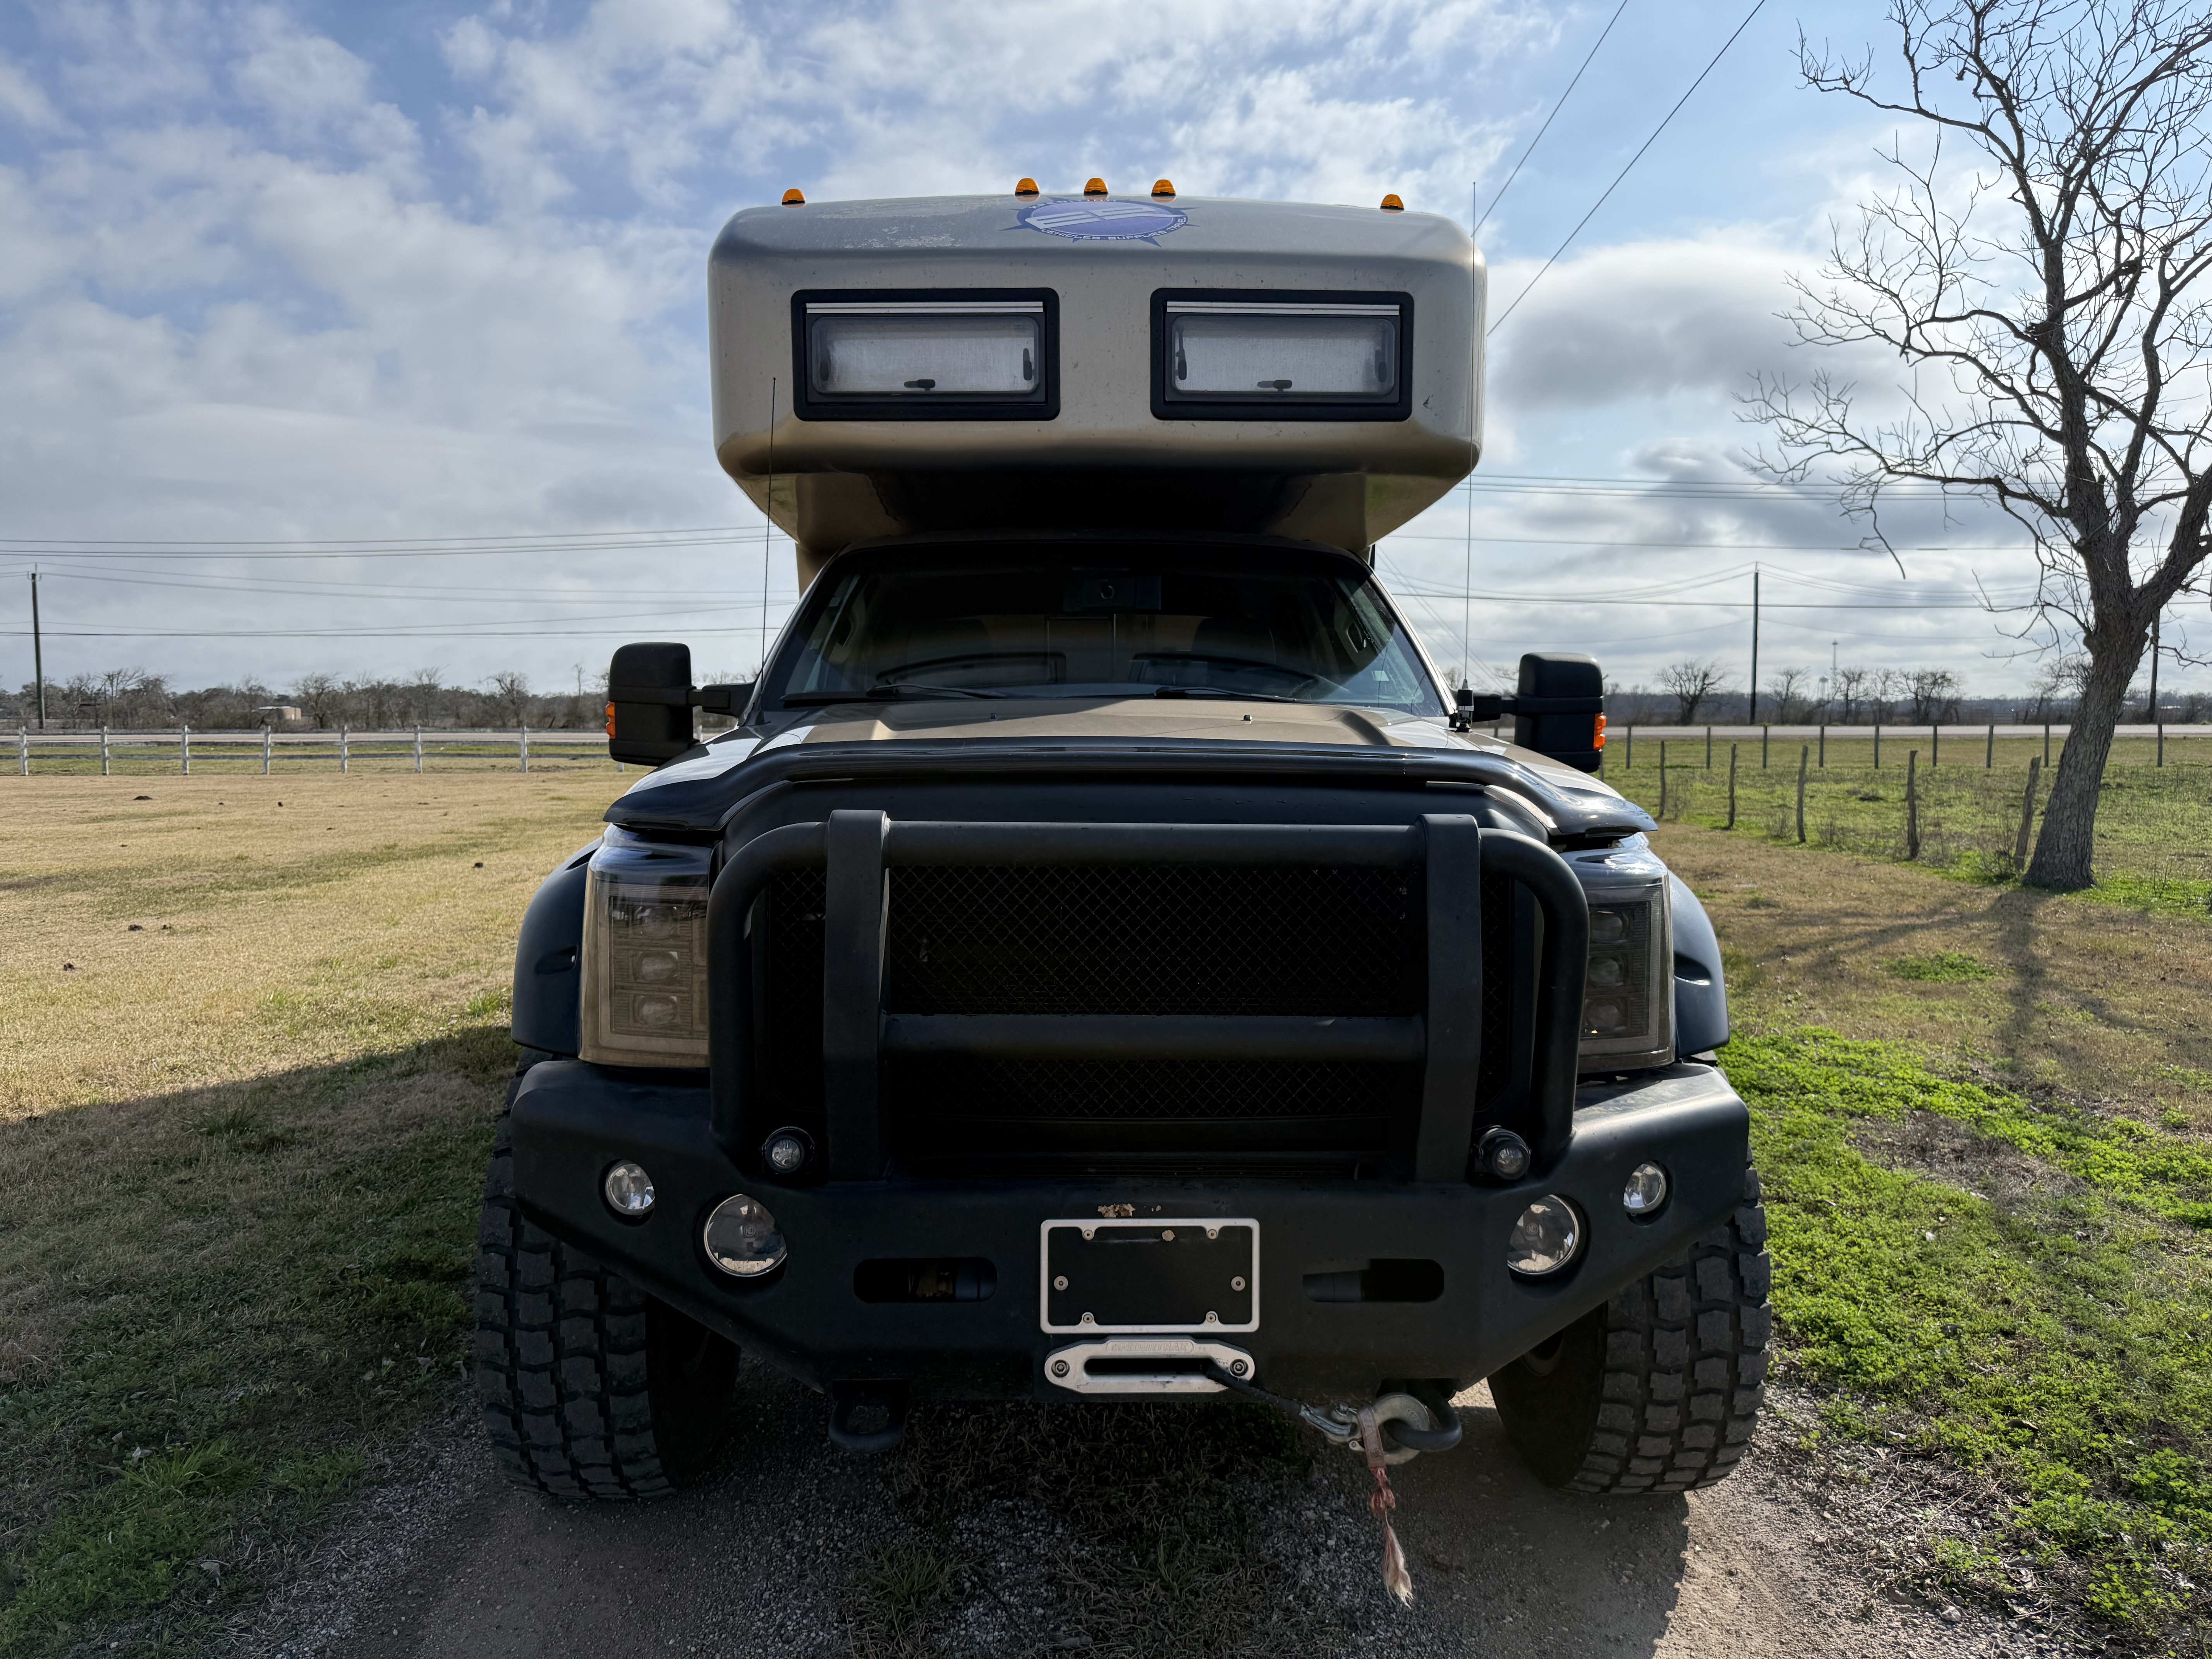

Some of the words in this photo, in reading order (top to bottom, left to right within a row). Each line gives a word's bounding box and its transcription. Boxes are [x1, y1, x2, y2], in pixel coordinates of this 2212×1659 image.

[1041, 229, 1100, 239] VEHICLES
[1108, 230, 1167, 240] SUPPLIES
[1111, 1343, 1187, 1352] SPIDERTRAX
